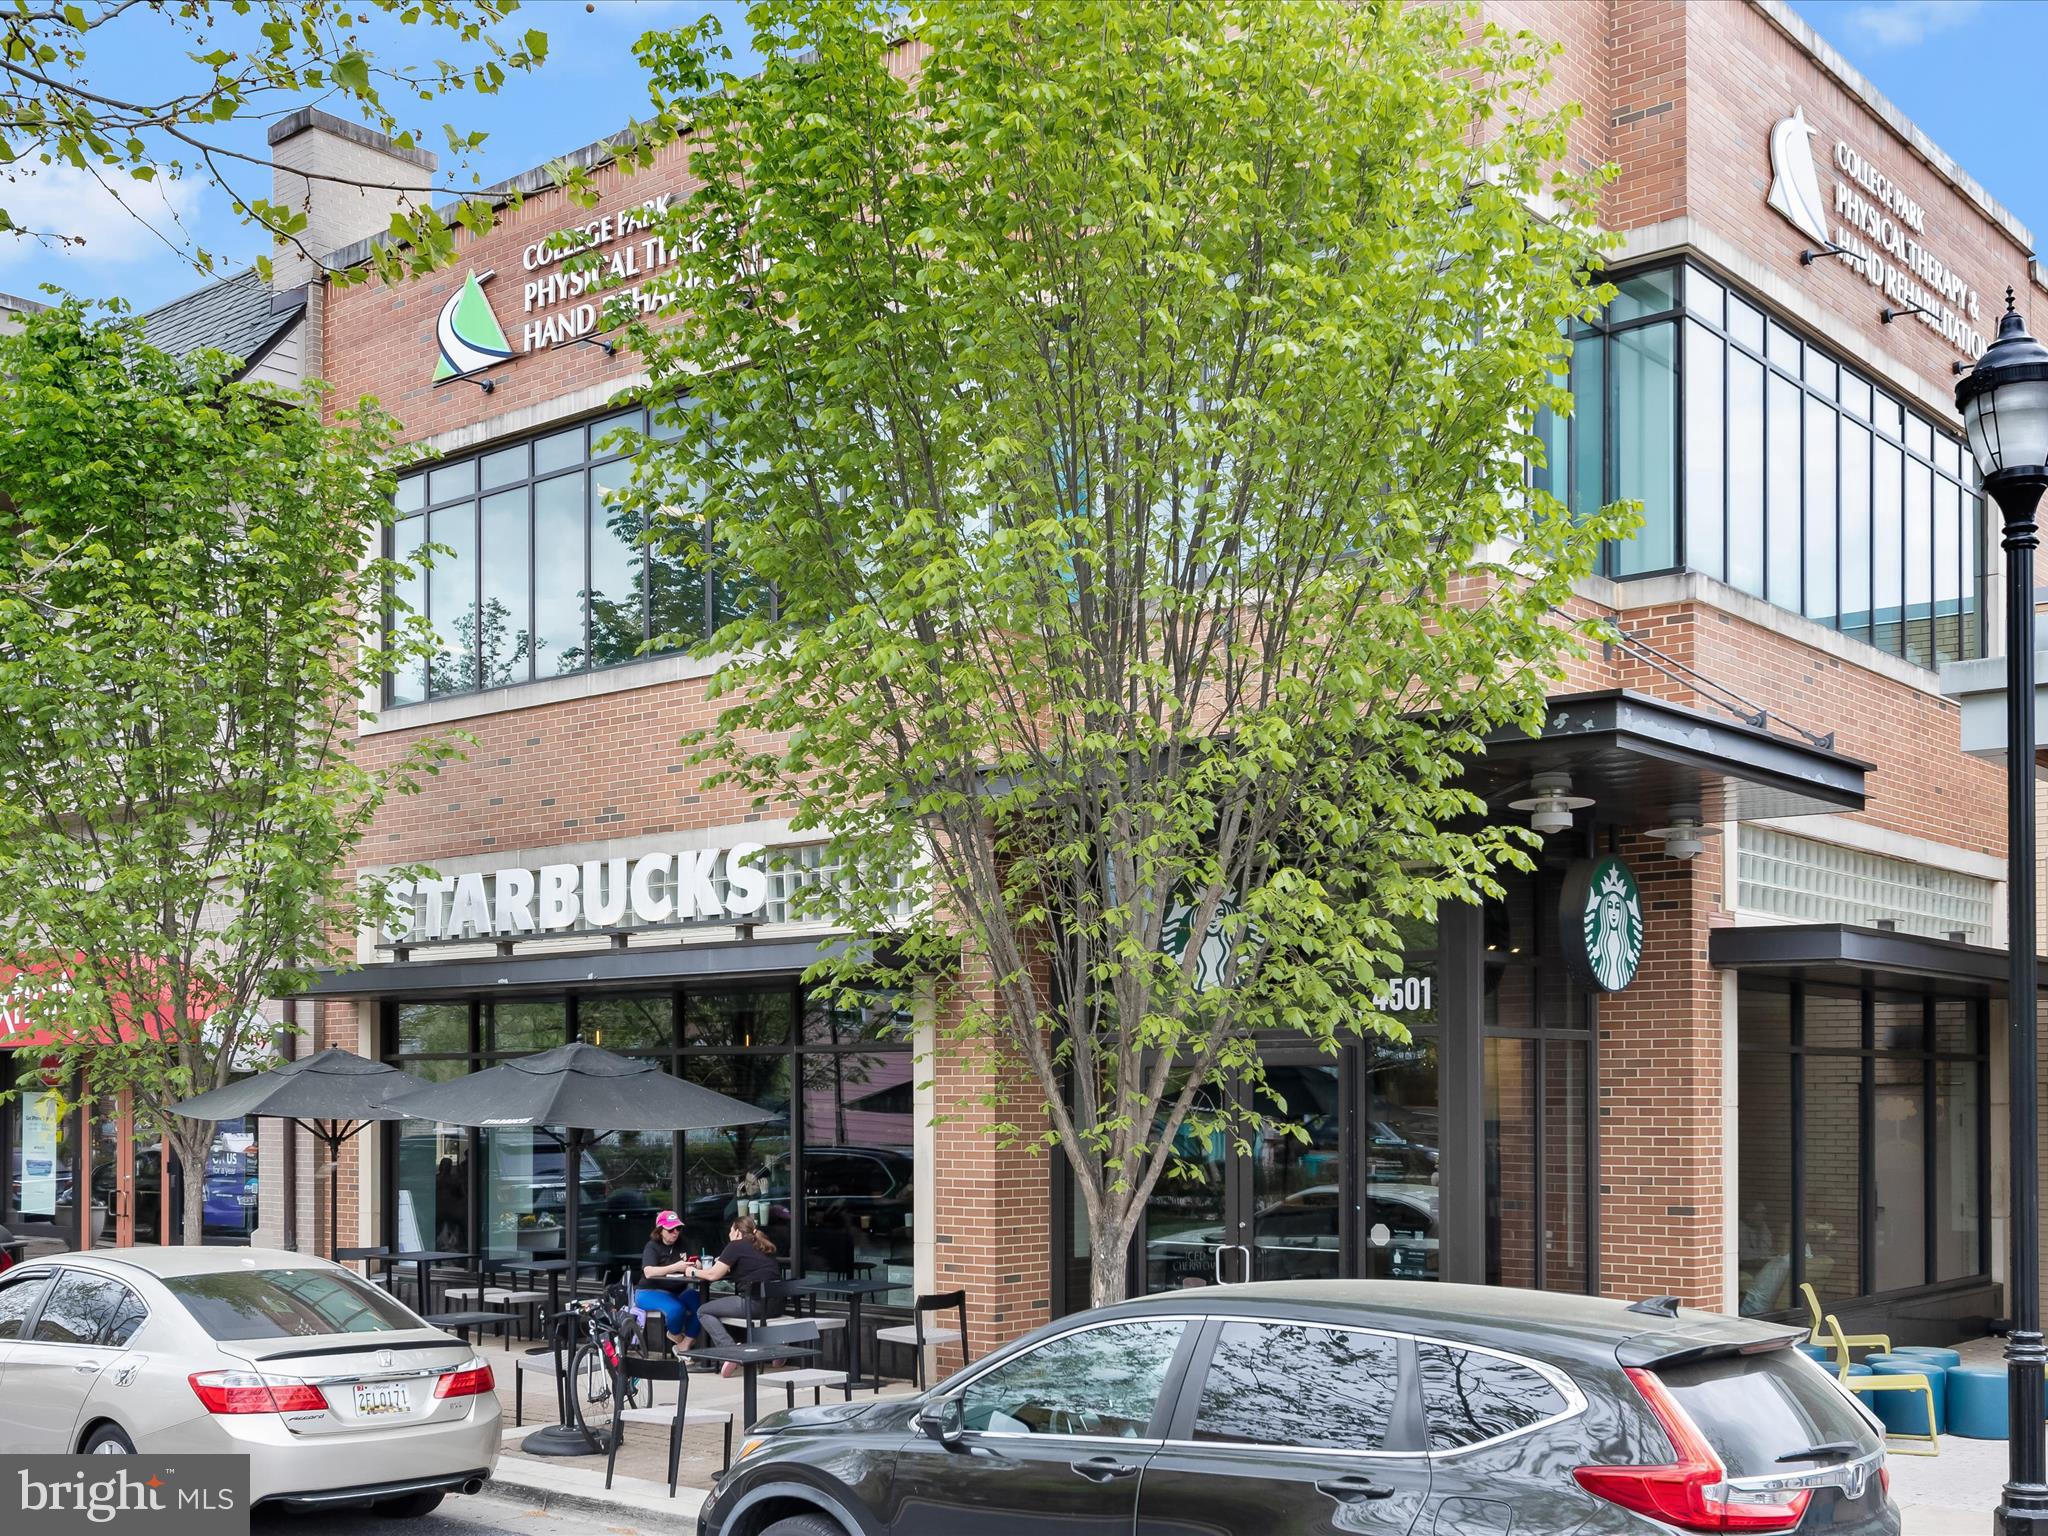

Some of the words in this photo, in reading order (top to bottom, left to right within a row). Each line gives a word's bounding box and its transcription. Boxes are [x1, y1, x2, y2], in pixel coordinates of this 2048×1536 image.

[1836, 141, 1893, 209] COLLEGE
[1895, 189, 1925, 236] PARK
[1836, 181, 1909, 263] PHYSICAL
[1905, 239, 1968, 309] THERAPY
[1968, 290, 1980, 322] &
[1836, 226, 1884, 287] HAND
[523, 303, 597, 353] HAND
[382, 842, 767, 941] STARBUCKS
[1372, 977, 1431, 1011] 4501
[226, 1153, 237, 1165] US
